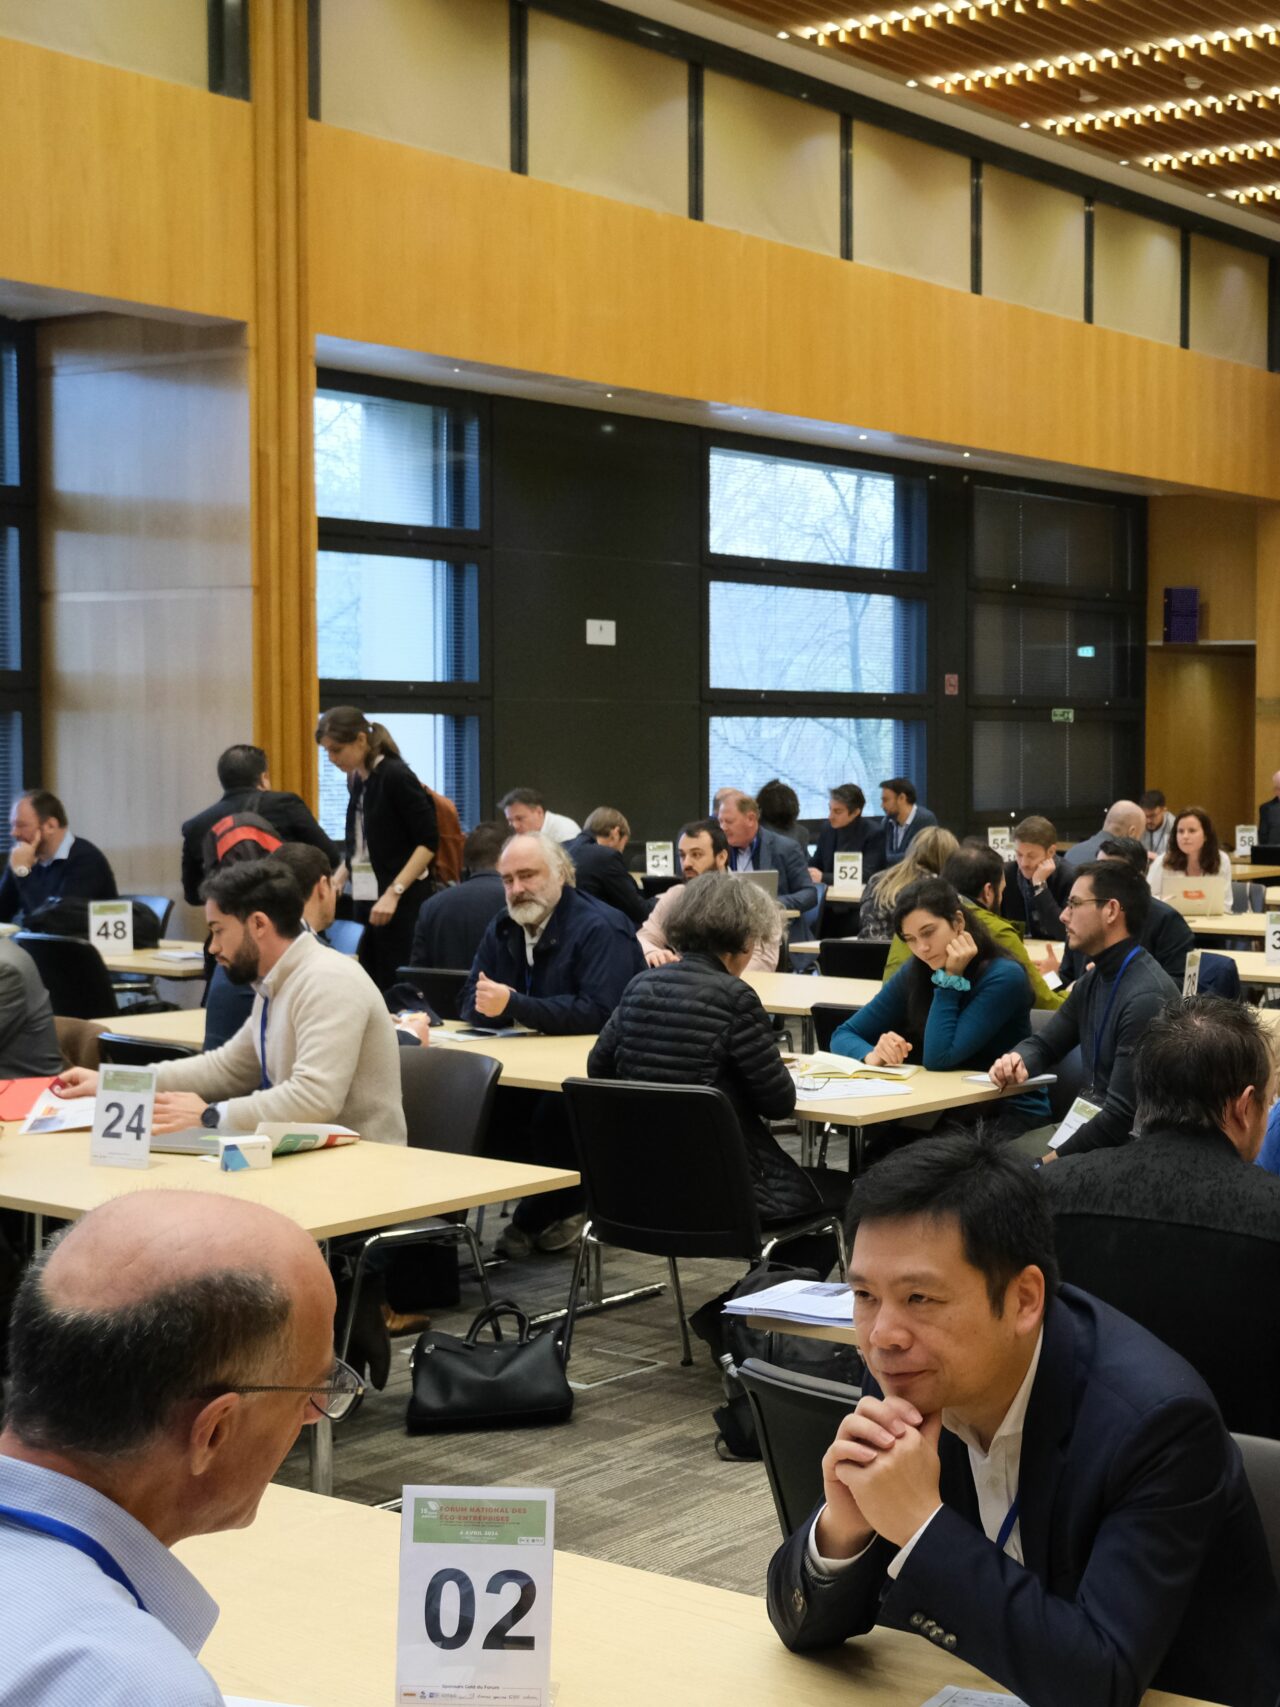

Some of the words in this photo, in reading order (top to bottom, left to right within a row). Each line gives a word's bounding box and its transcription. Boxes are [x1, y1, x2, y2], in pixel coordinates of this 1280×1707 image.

[992, 838, 1007, 850] 55
[1240, 836, 1255, 847] 58
[838, 866, 858, 880] 52
[96, 920, 126, 940] 48
[101, 1102, 146, 1141] 24
[469, 1506, 510, 1514] NATIONAL
[424, 1567, 537, 1651] 02
